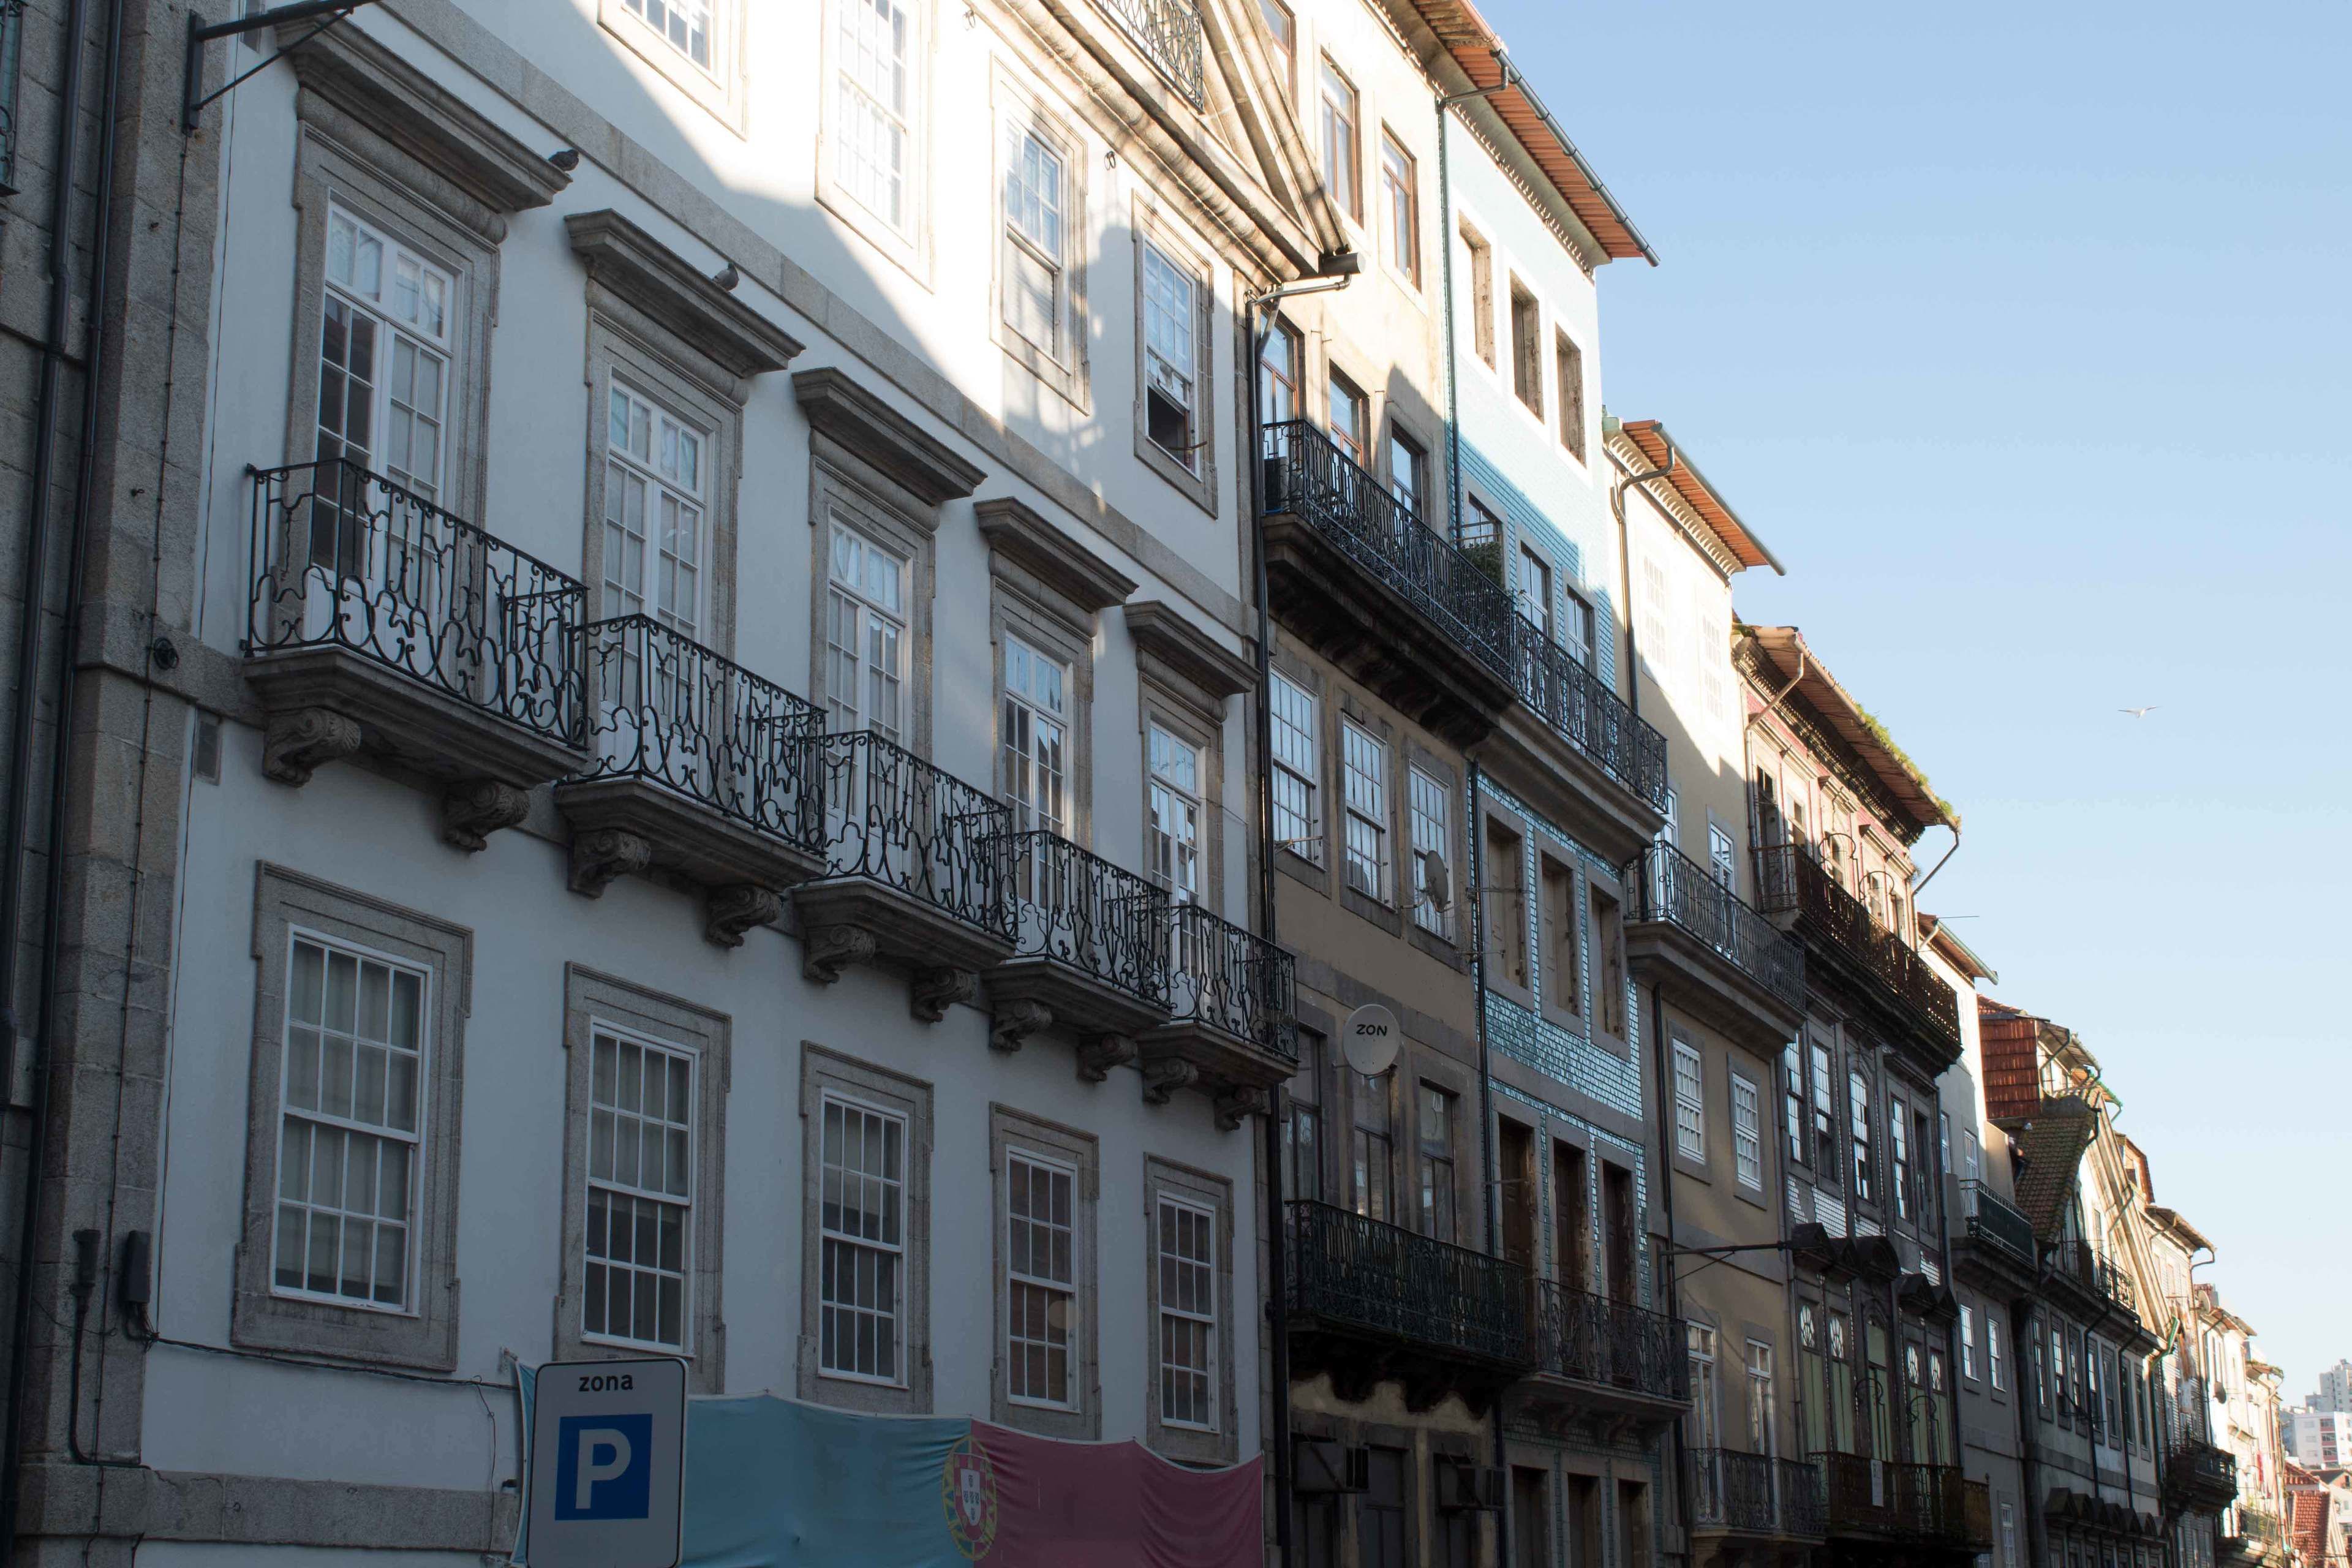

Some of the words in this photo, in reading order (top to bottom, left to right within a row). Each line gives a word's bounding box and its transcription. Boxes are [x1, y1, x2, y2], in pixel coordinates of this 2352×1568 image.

[1356, 1024, 1387, 1036] ZON
[578, 1374, 634, 1392] zona
[575, 1428, 631, 1509] P
